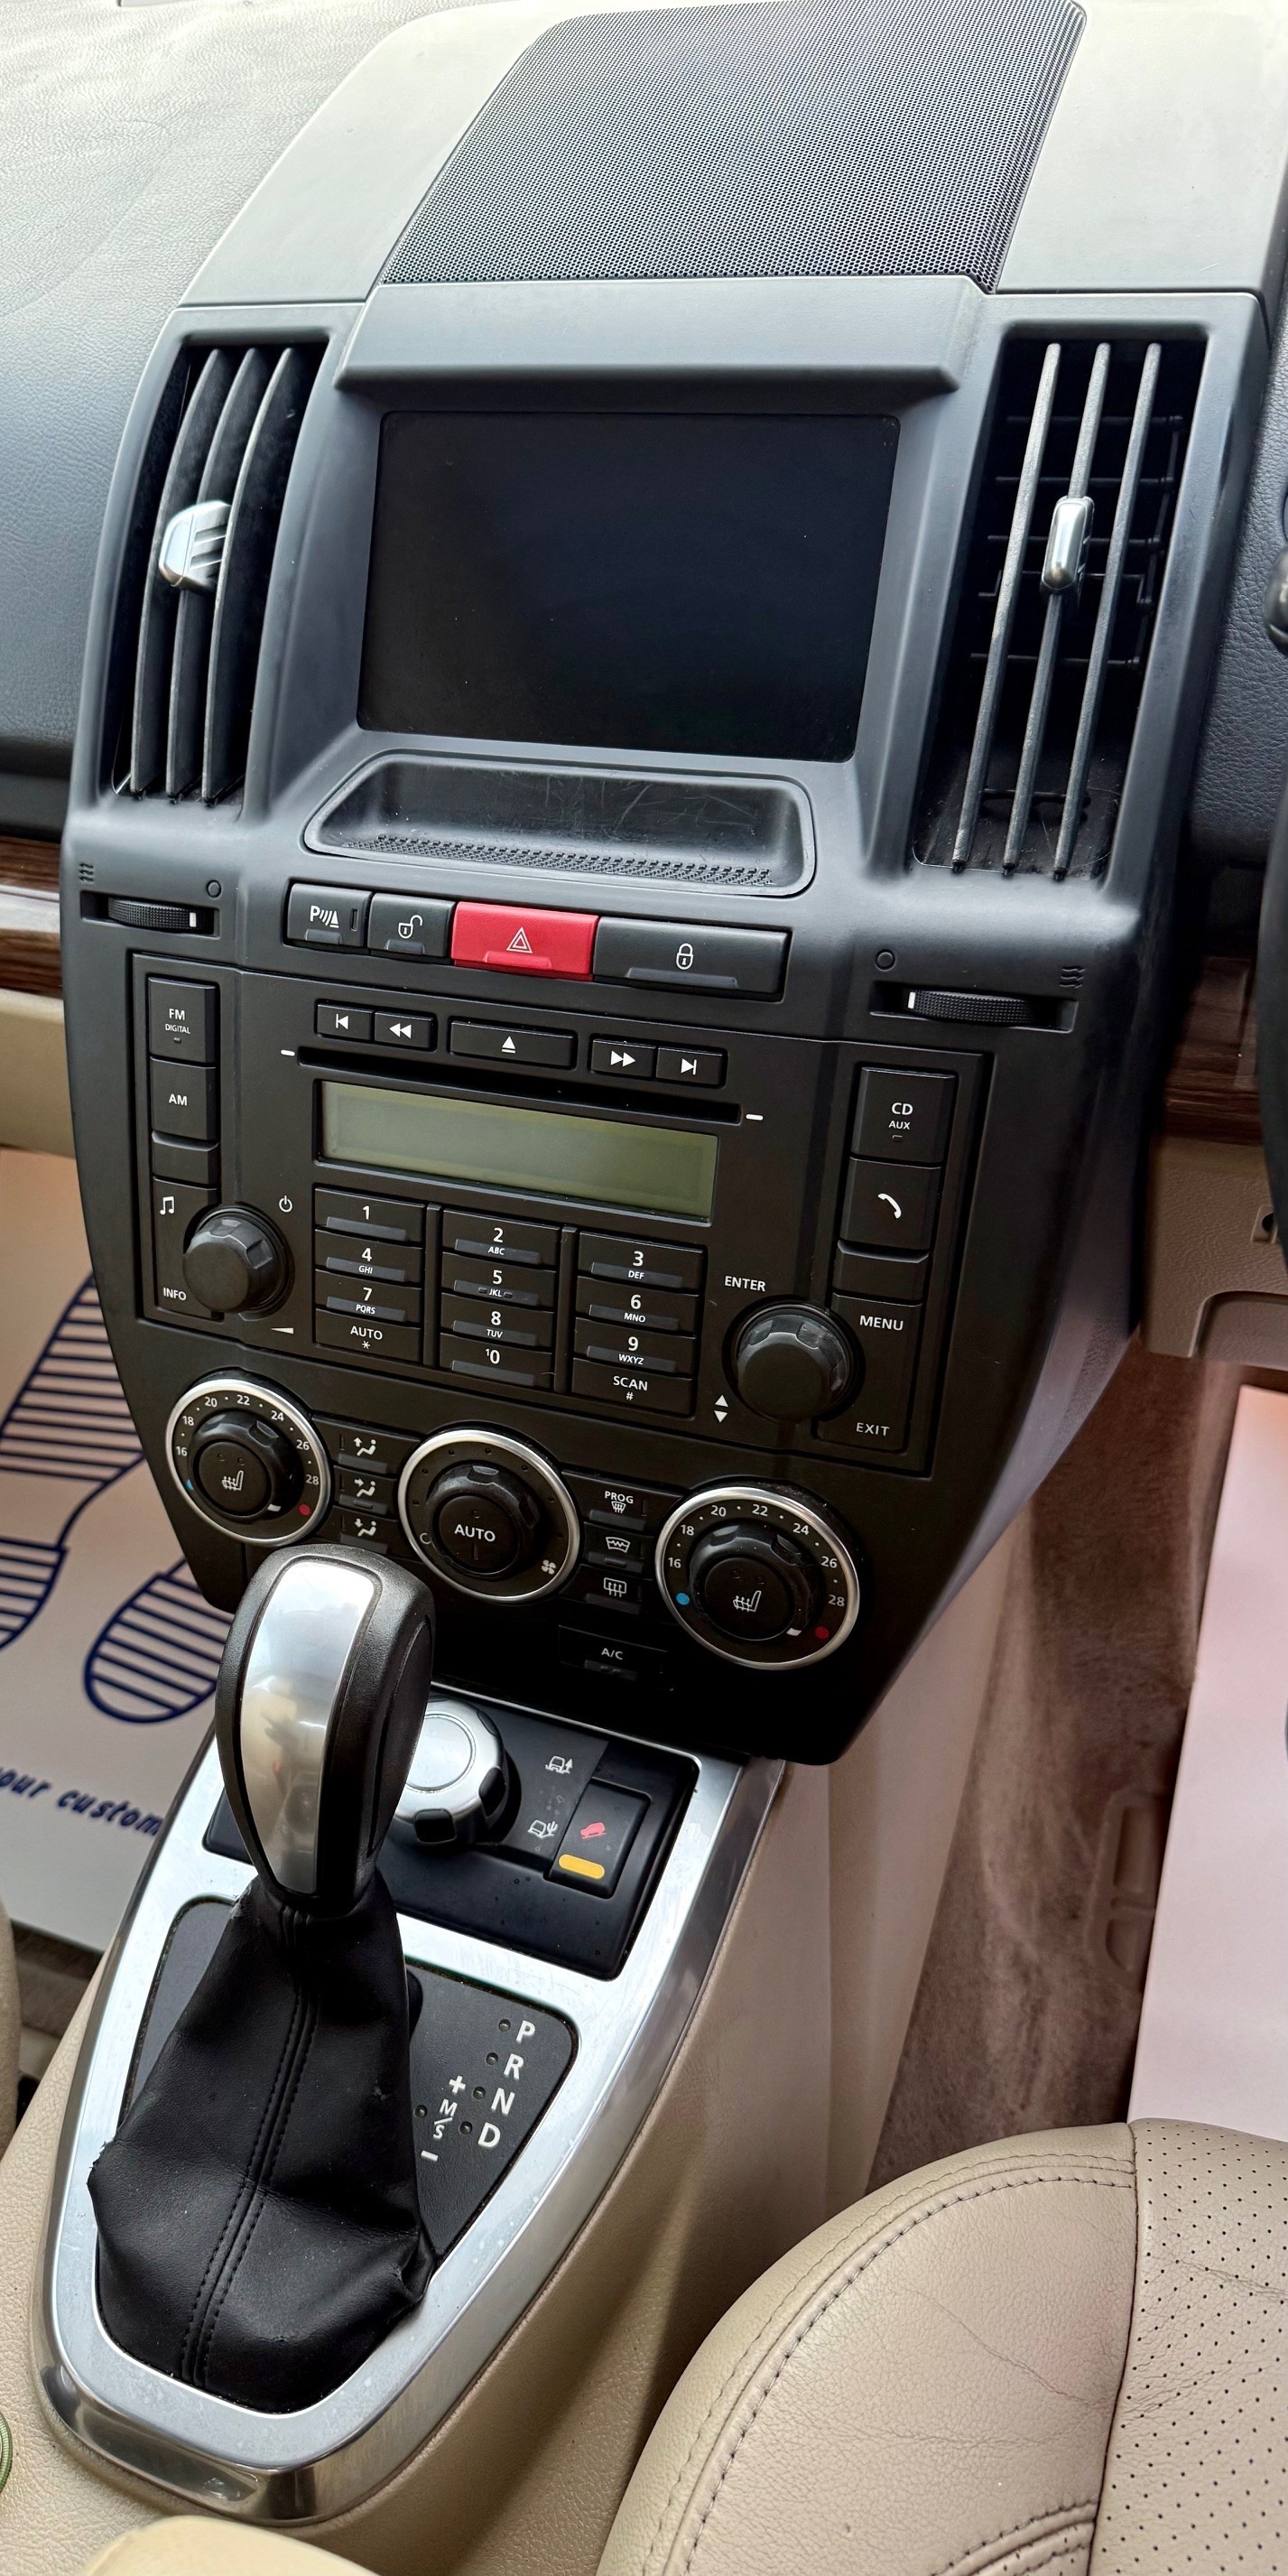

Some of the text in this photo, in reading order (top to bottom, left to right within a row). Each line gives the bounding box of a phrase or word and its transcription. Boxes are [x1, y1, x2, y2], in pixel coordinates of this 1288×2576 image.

[169, 1008, 185, 1021] FM
[164, 1023, 191, 1035] DIGITAL
[168, 1093, 188, 1106] AM
[891, 1102, 913, 1115] CD
[888, 1120, 911, 1130] AUX
[362, 1205, 370, 1220] 1
[493, 1227, 504, 1243] 2
[361, 1247, 373, 1262] 4
[487, 1246, 505, 1256] ABC
[632, 1251, 644, 1267] 3
[358, 1265, 374, 1275] GHI
[492, 1269, 503, 1285] 5
[627, 1269, 645, 1279] DEF
[724, 1275, 766, 1292] ENTER
[162, 1287, 187, 1301] INFO
[363, 1287, 373, 1301] 7
[488, 1288, 503, 1297] JKL
[630, 1294, 642, 1310] 6
[356, 1304, 376, 1315] PQRS
[490, 1310, 502, 1326] 8
[624, 1312, 646, 1323] MNO
[859, 1315, 903, 1331] MENU
[349, 1325, 383, 1341] AUTO
[486, 1328, 504, 1339] TUV
[627, 1336, 639, 1352] 9
[618, 1353, 644, 1365] WXYZ
[613, 1375, 648, 1391] SCAN
[204, 1396, 218, 1408] 20
[236, 1394, 251, 1407] 22
[182, 1415, 195, 1427] 18
[270, 1409, 285, 1422] 24
[856, 1422, 890, 1437] EXIT
[175, 1446, 188, 1457] 16
[295, 1438, 310, 1451] 26
[305, 1474, 320, 1486] 28
[604, 1490, 635, 1505] PROG
[709, 1504, 727, 1518] 20
[751, 1503, 769, 1517] 22
[454, 1523, 496, 1542] AUTO
[679, 1523, 696, 1537] 18
[792, 1522, 810, 1536] 24
[667, 1557, 681, 1568] 16
[820, 1555, 839, 1569] 26
[828, 1594, 845, 1607] 28
[601, 1647, 623, 1660] A/C
[515, 2020, 536, 2042] P
[503, 2053, 524, 2080] R
[490, 2088, 515, 2116] N
[477, 2122, 501, 2148] D
